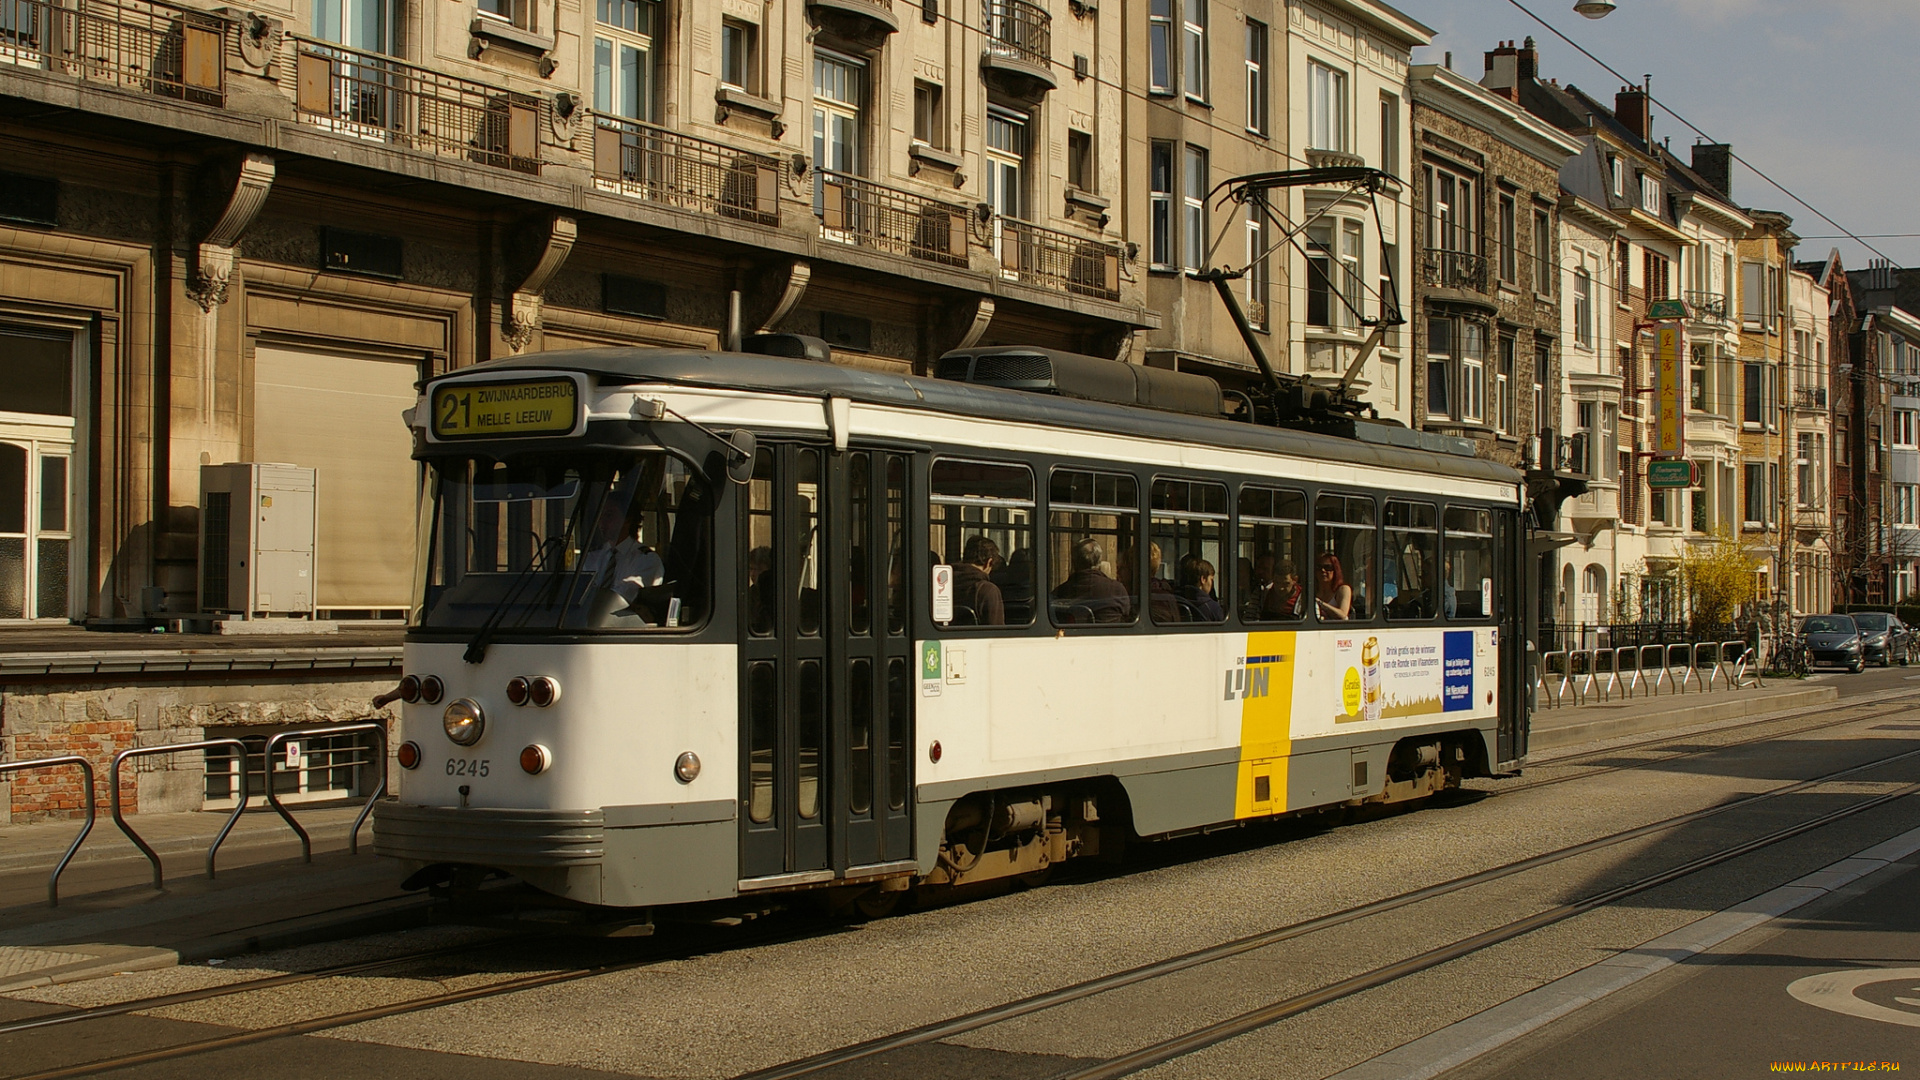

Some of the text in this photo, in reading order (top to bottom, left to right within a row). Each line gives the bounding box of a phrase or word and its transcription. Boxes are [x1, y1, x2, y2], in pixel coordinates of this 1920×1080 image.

[478, 385, 574, 404] ZWIJNAARDEBRUG
[441, 393, 471, 430] 21
[477, 410, 553, 427] MELLE LEEUW
[1237, 656, 1244, 665] DE
[1484, 666, 1495, 677] 6245
[445, 758, 490, 777] 6245
